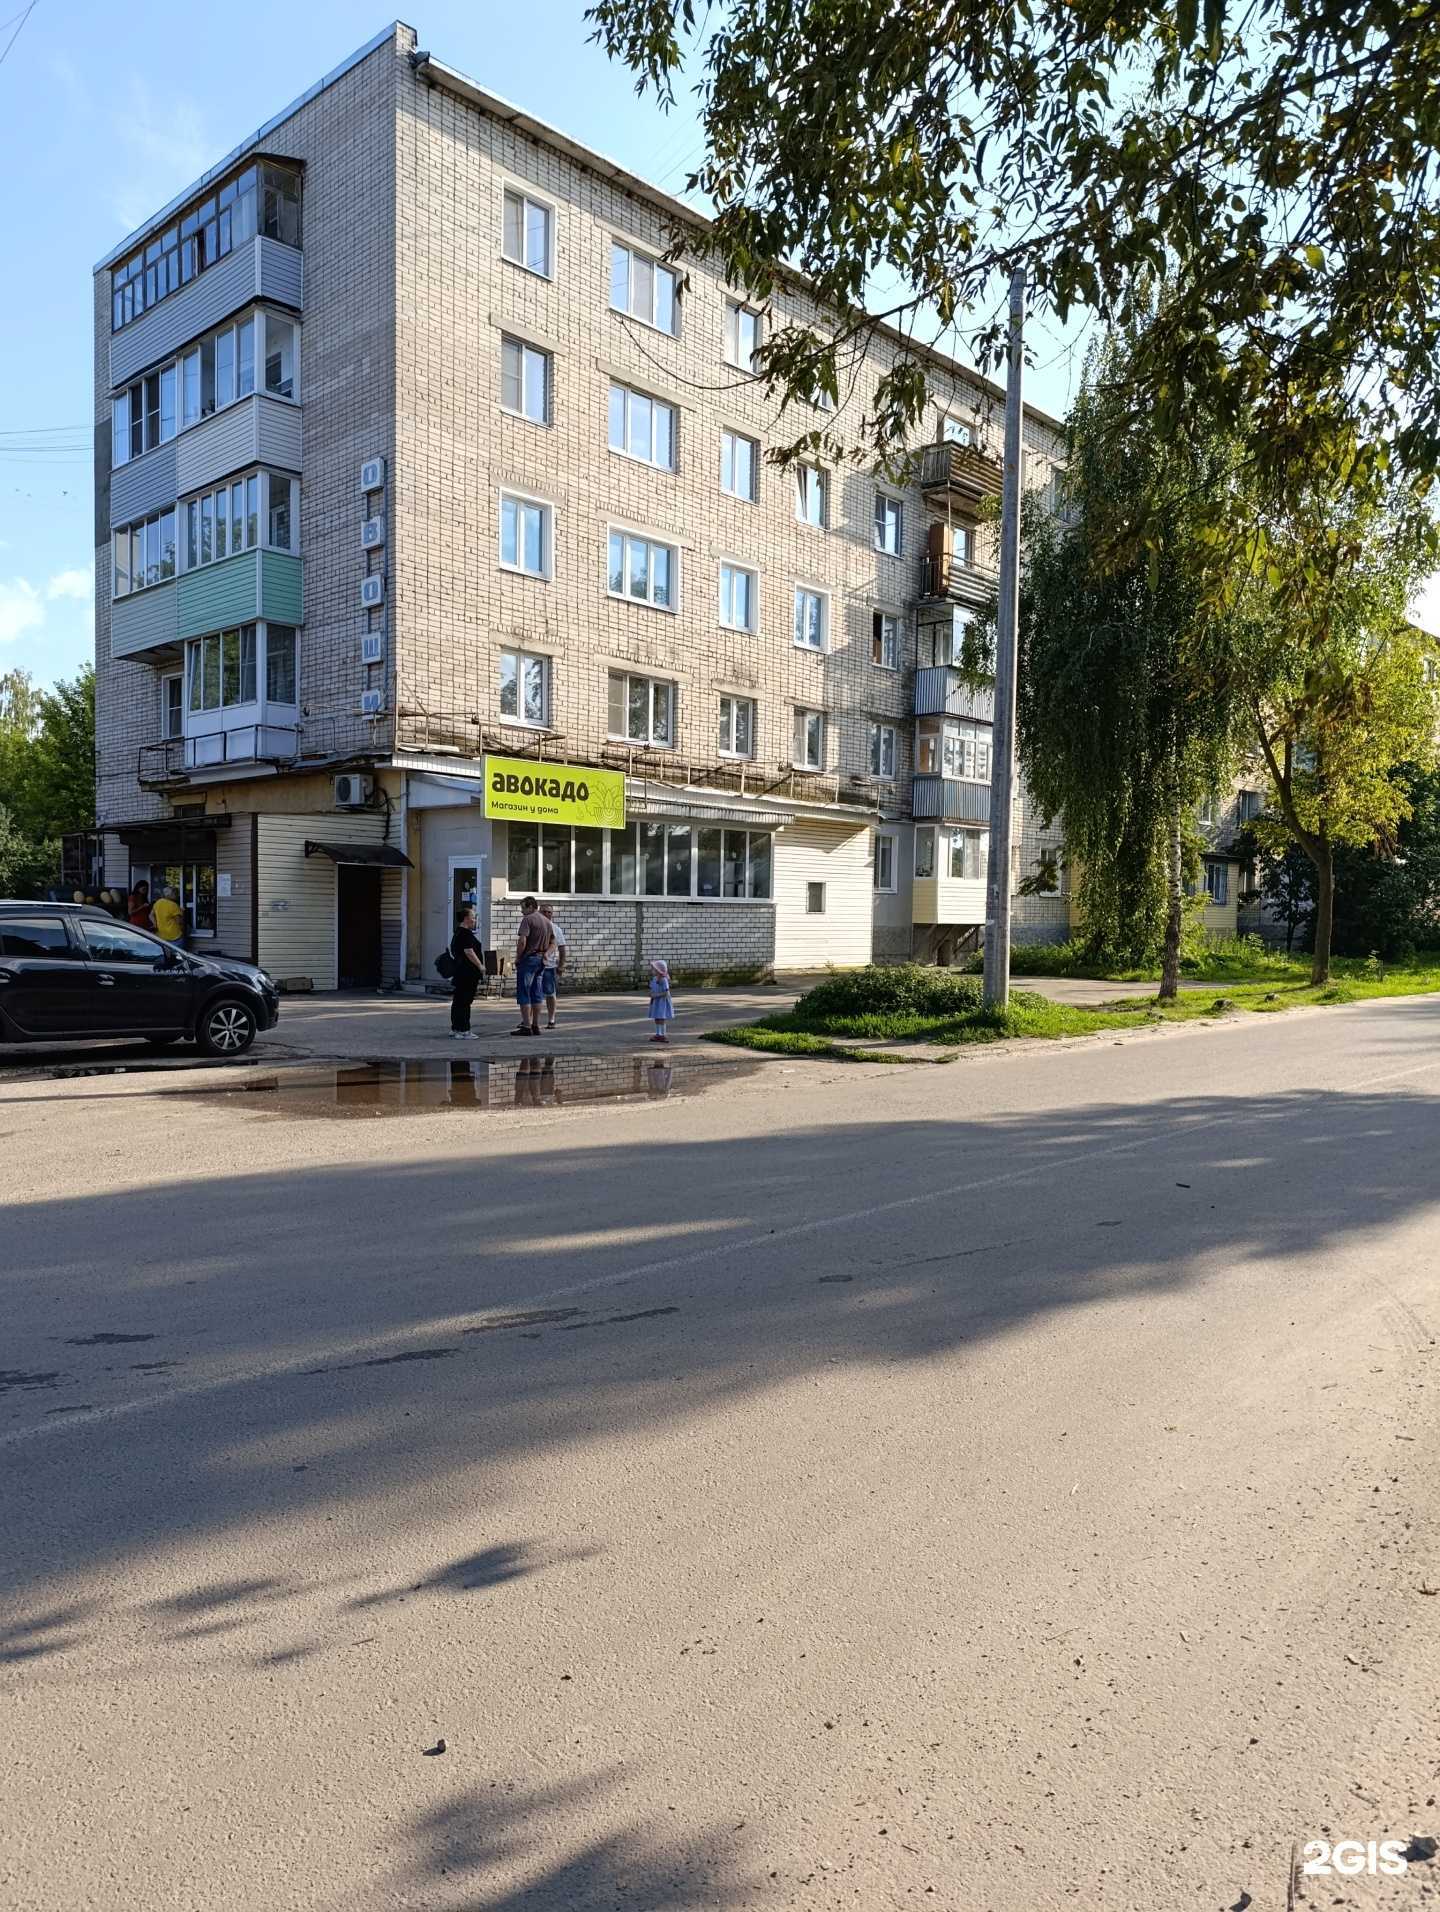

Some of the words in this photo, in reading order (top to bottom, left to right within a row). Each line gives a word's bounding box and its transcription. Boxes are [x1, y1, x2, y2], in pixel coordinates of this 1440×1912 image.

[491, 772, 590, 803] авокадо
[491, 800, 528, 812] Магазин
[530, 806, 536, 814] у
[537, 806, 559, 815] дома
